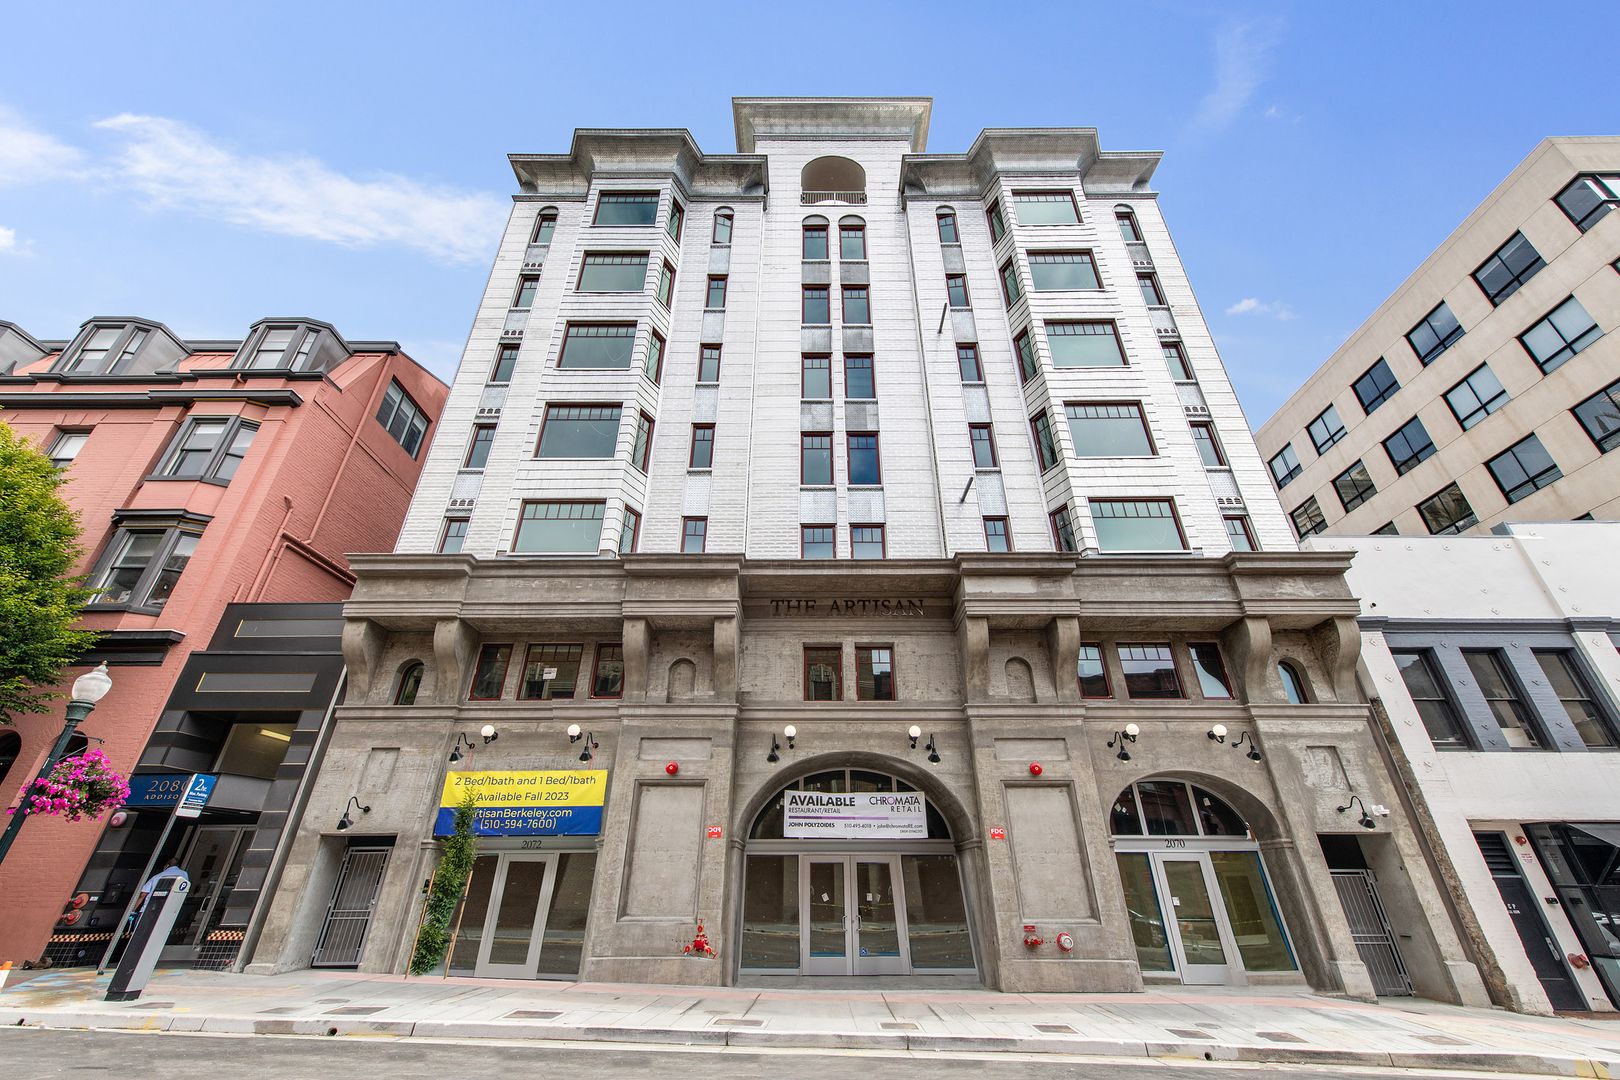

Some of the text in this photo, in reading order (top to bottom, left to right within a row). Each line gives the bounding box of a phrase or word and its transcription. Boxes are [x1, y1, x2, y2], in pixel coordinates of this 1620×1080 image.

[770, 599, 925, 617] THE ARTISAN
[454, 775, 596, 787] 2 Bed/1bath and 1 Bed/1bath
[476, 791, 569, 802] Available Fall 2023
[789, 795, 856, 807] AVAILABLE
[868, 796, 921, 806] CHROMATA
[472, 808, 573, 820] rtisanBerkeley.com
[890, 805, 922, 813] RETAIL
[480, 817, 557, 830] (510-594-7600)
[521, 840, 542, 849] 2072
[1164, 838, 1186, 848] 2070
